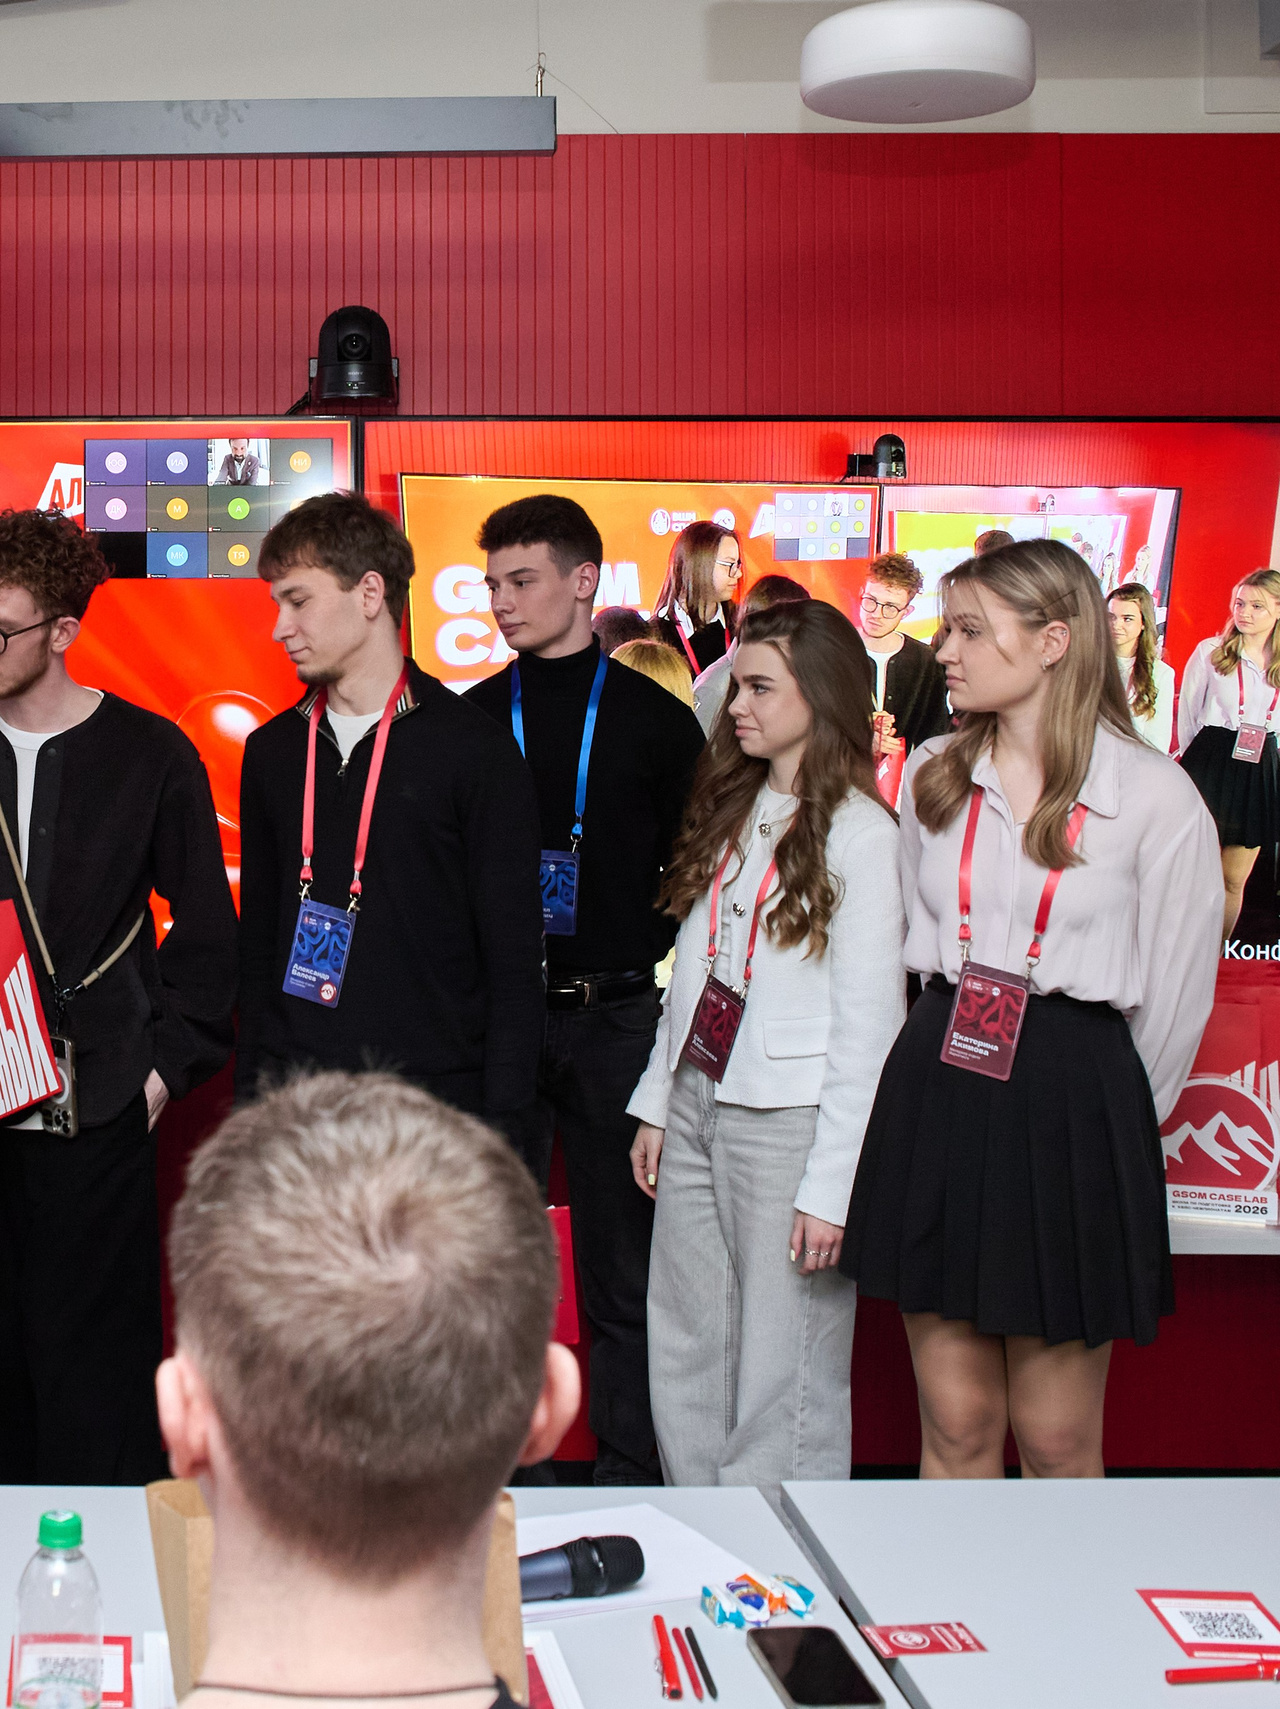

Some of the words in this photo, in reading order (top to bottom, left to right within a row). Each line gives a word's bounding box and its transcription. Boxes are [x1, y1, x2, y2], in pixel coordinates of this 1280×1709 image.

[293, 457, 308, 466] НИ
[110, 505, 122, 514] ДК
[170, 551, 184, 560] МК
[232, 551, 245, 560] ТЯ
[952, 1031, 999, 1052] Екатерина
[1172, 1190, 1207, 1199] GSOM
[1209, 1193, 1242, 1202] CASE
[1244, 1195, 1268, 1204] LAB
[1235, 1204, 1268, 1215] 2026
